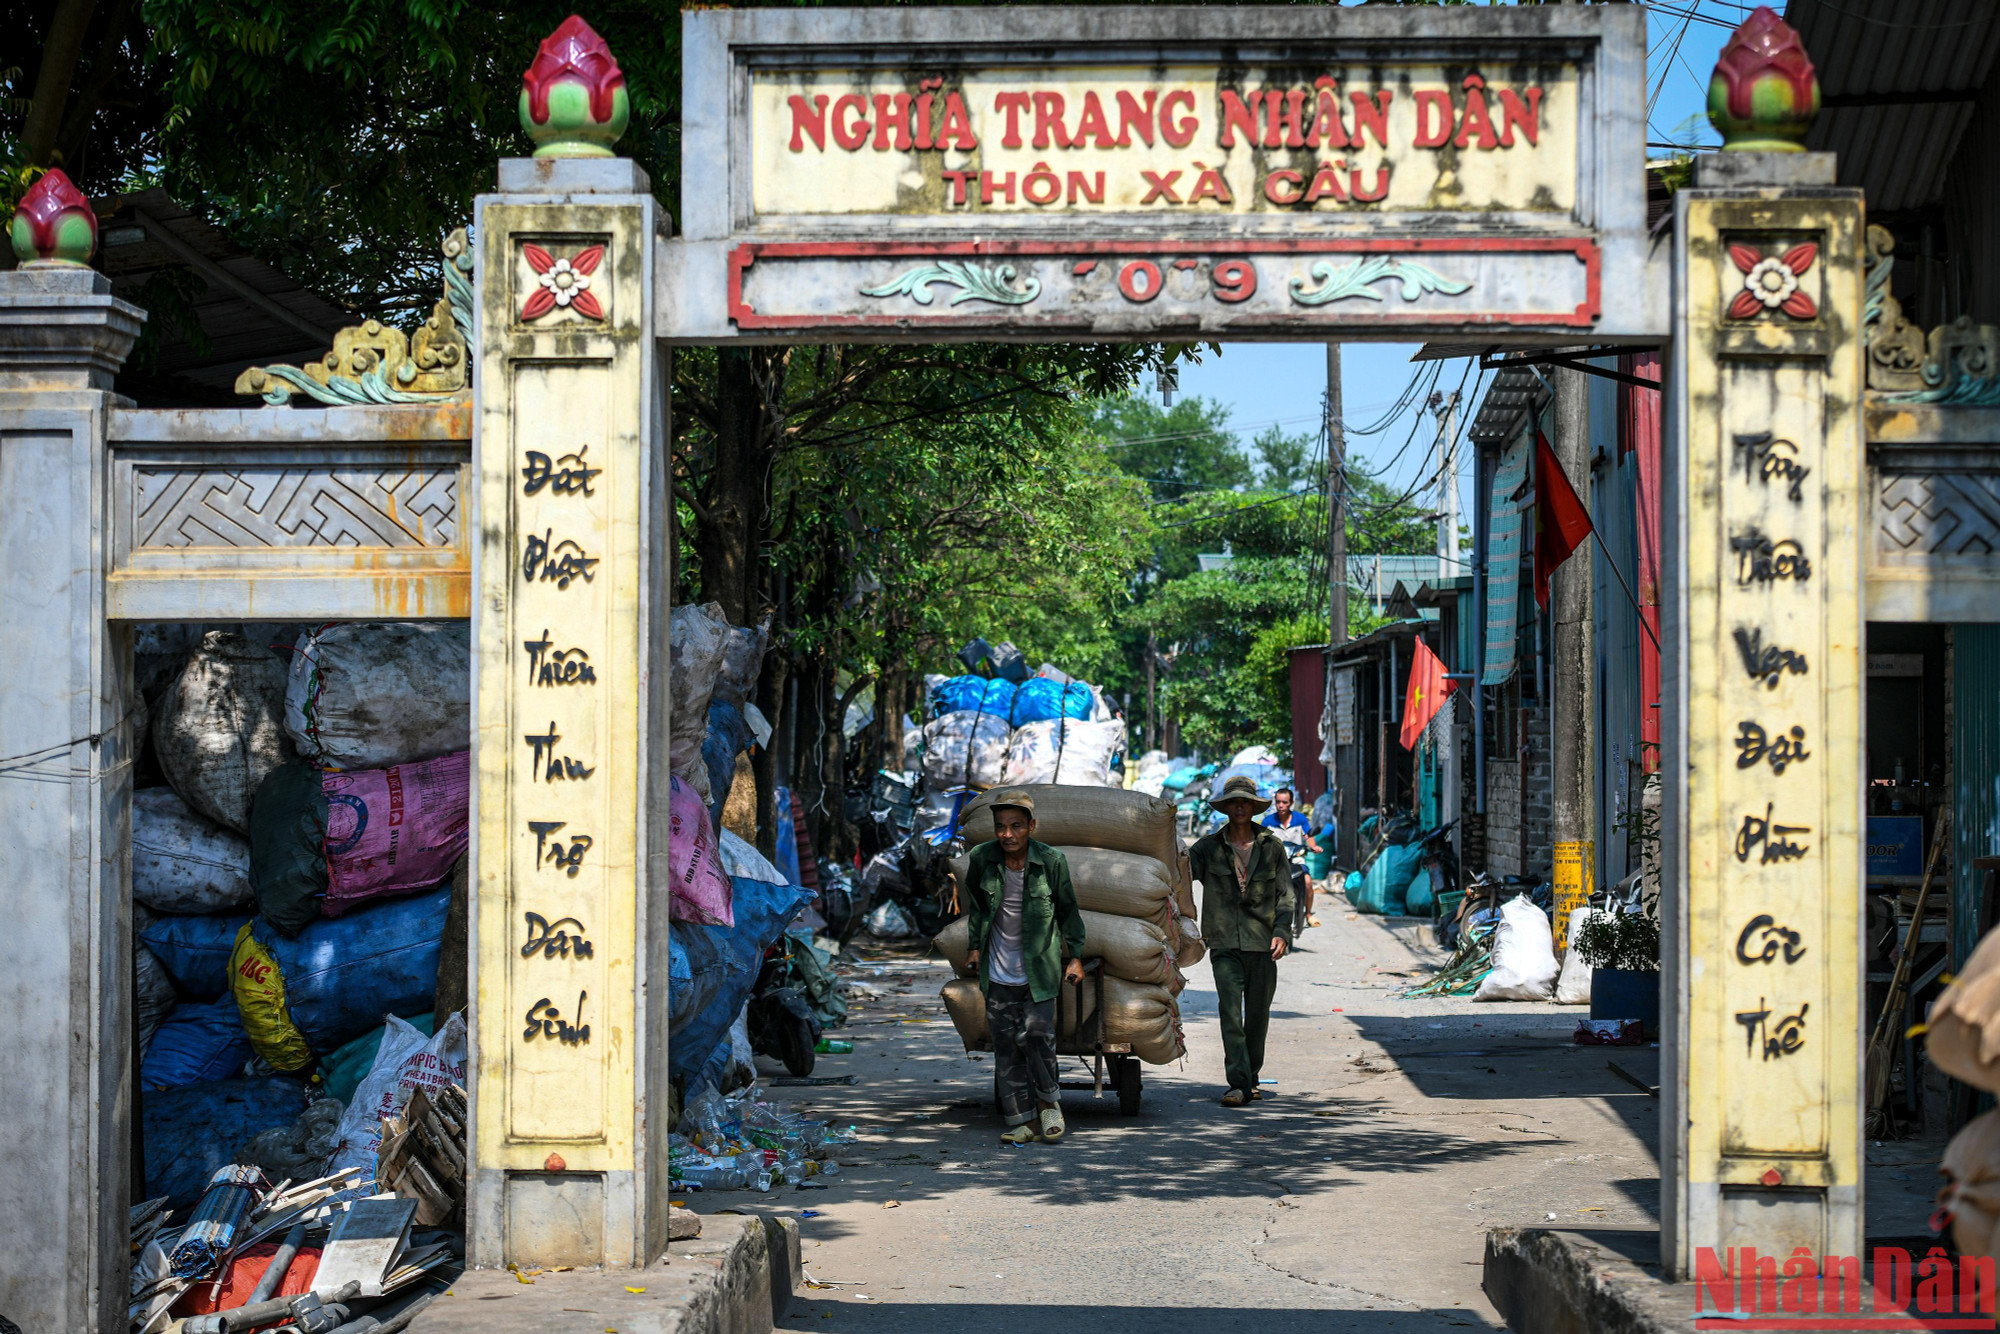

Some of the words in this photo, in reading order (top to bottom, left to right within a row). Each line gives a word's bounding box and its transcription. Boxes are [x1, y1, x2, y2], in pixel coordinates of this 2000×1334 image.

[787, 76, 978, 151] NGHĨA
[994, 90, 1199, 149] TRANG
[1220, 74, 1393, 149] NHÂN
[1412, 74, 1543, 149] DÂN
[942, 161, 1106, 205] THÔN
[1139, 160, 1230, 204] XÀ
[1264, 159, 1389, 204] CẦU
[1071, 260, 1257, 302] 009
[522, 444, 602, 497] Đất
[1732, 431, 1811, 501] Tây
[523, 528, 600, 590] Phật
[524, 628, 597, 687] Thiên
[1733, 627, 1808, 690] Vạn
[524, 720, 596, 784] Thu
[1735, 721, 1810, 775] Đại
[527, 821, 593, 878] Trợ
[521, 911, 594, 959] Dân
[239, 955, 272, 985] ABC
[523, 990, 590, 1048] Sinh
[1735, 997, 1809, 1061] Thế
